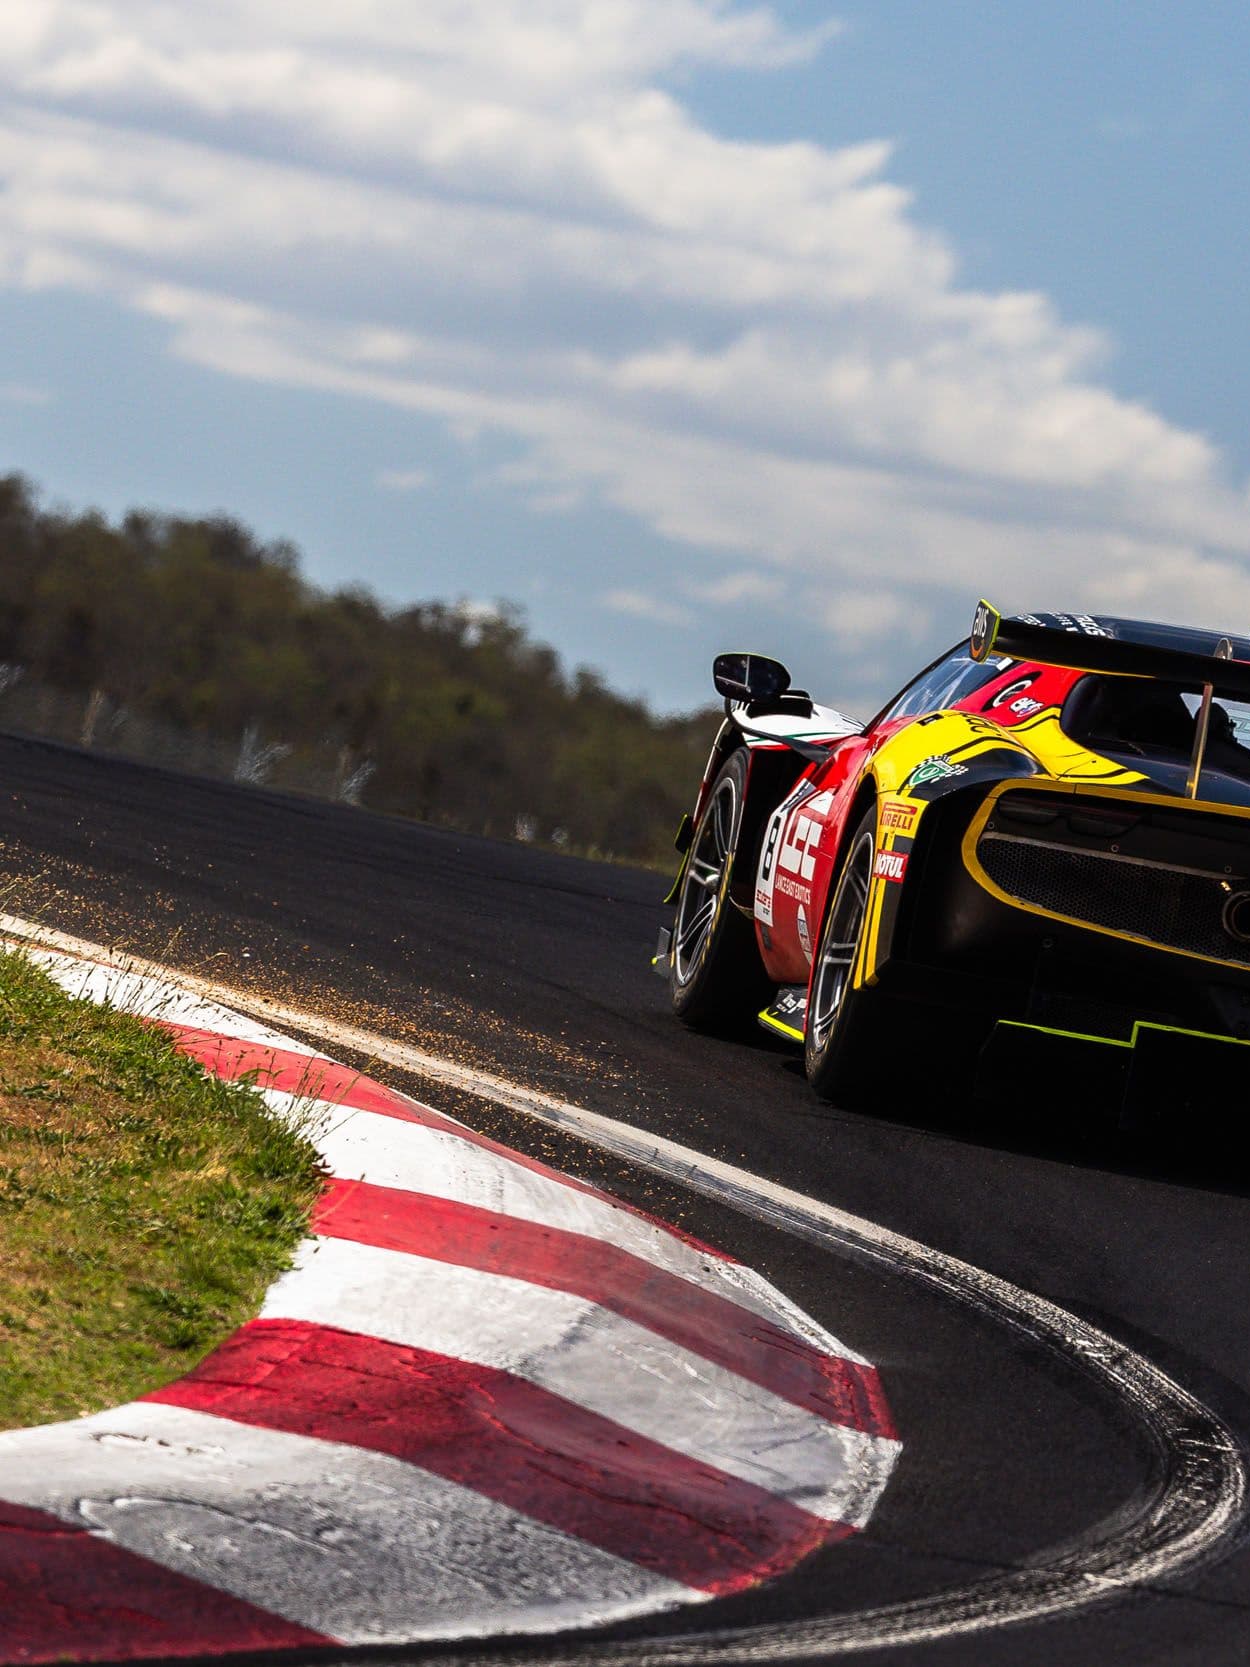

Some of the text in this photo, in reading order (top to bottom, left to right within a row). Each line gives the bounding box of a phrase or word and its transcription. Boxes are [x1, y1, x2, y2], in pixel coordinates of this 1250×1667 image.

[880, 802, 918, 830] PIRELLI
[761, 815, 782, 882] 8
[873, 852, 905, 879] MOTUL
